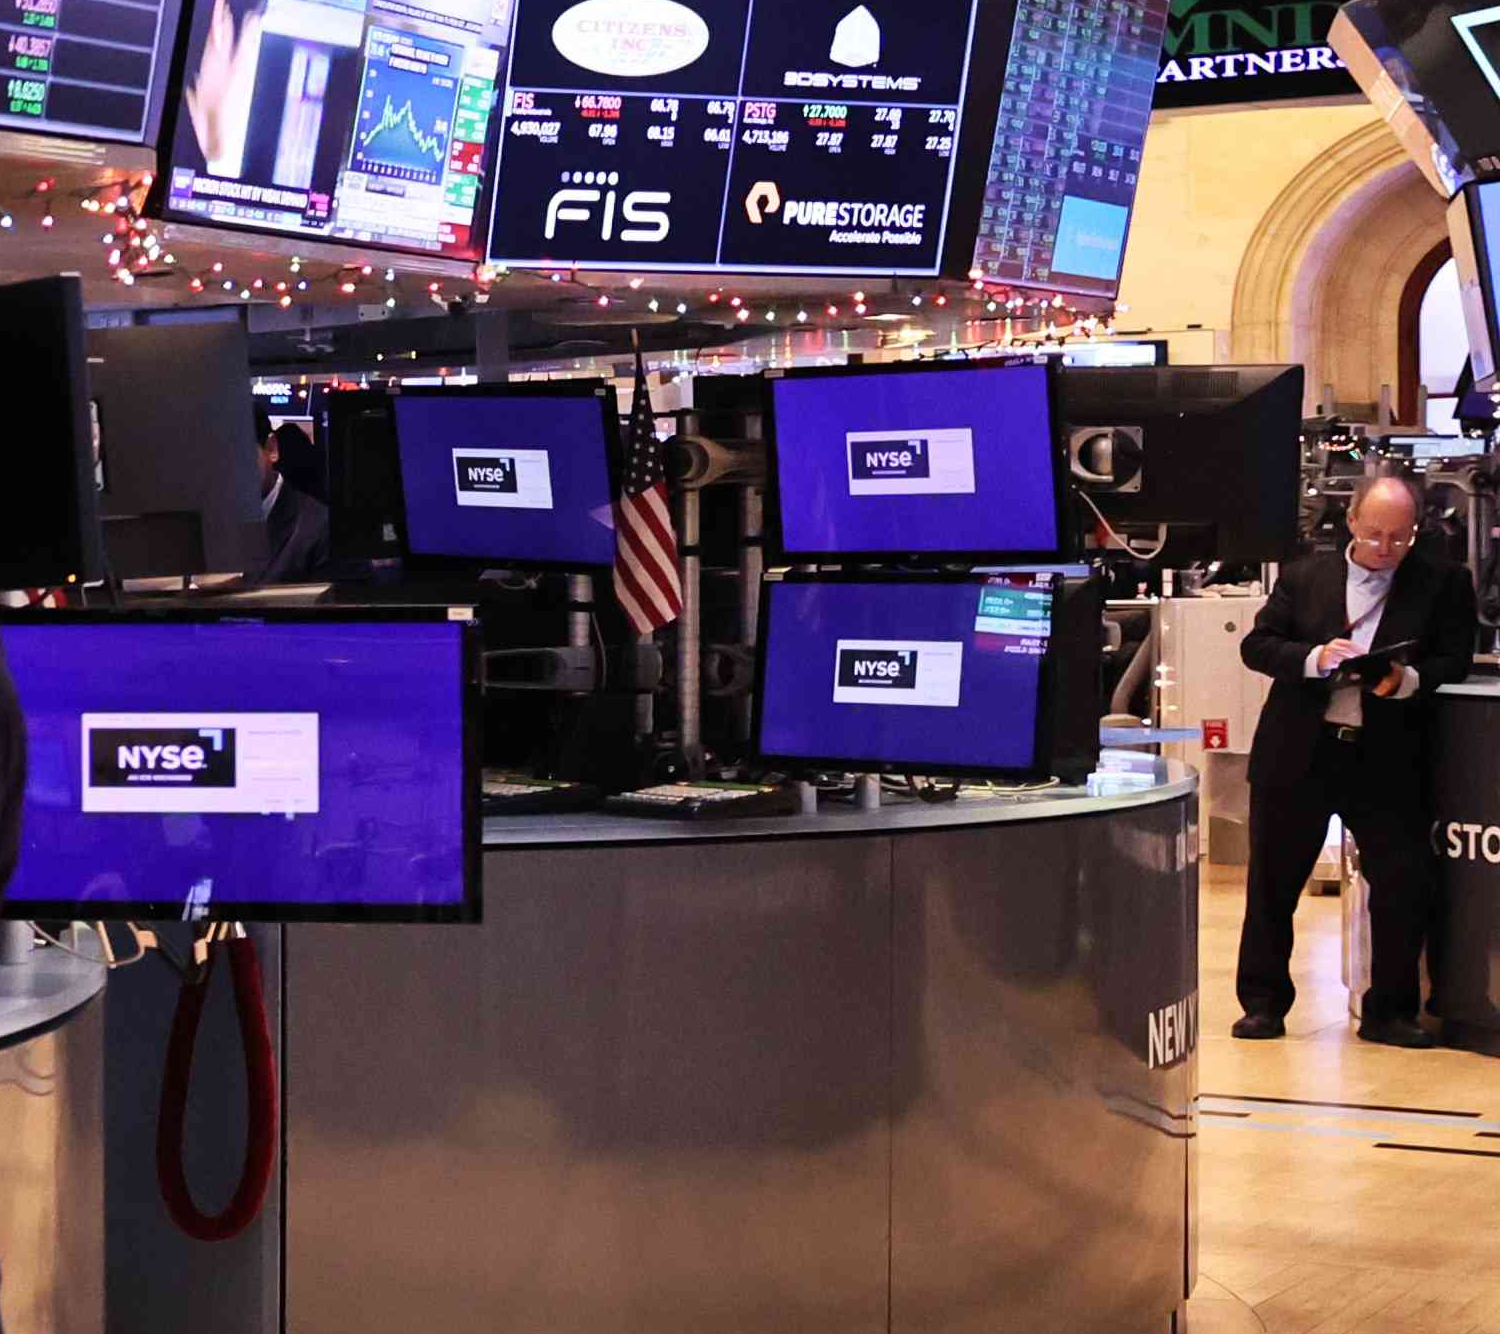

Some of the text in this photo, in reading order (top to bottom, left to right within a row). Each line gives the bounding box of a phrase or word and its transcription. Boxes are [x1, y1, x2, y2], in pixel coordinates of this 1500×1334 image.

[1156, 47, 1347, 83] ARTNER
[514, 92, 534, 109] FIS
[744, 103, 776, 119] PSTG
[544, 189, 672, 242] FIS
